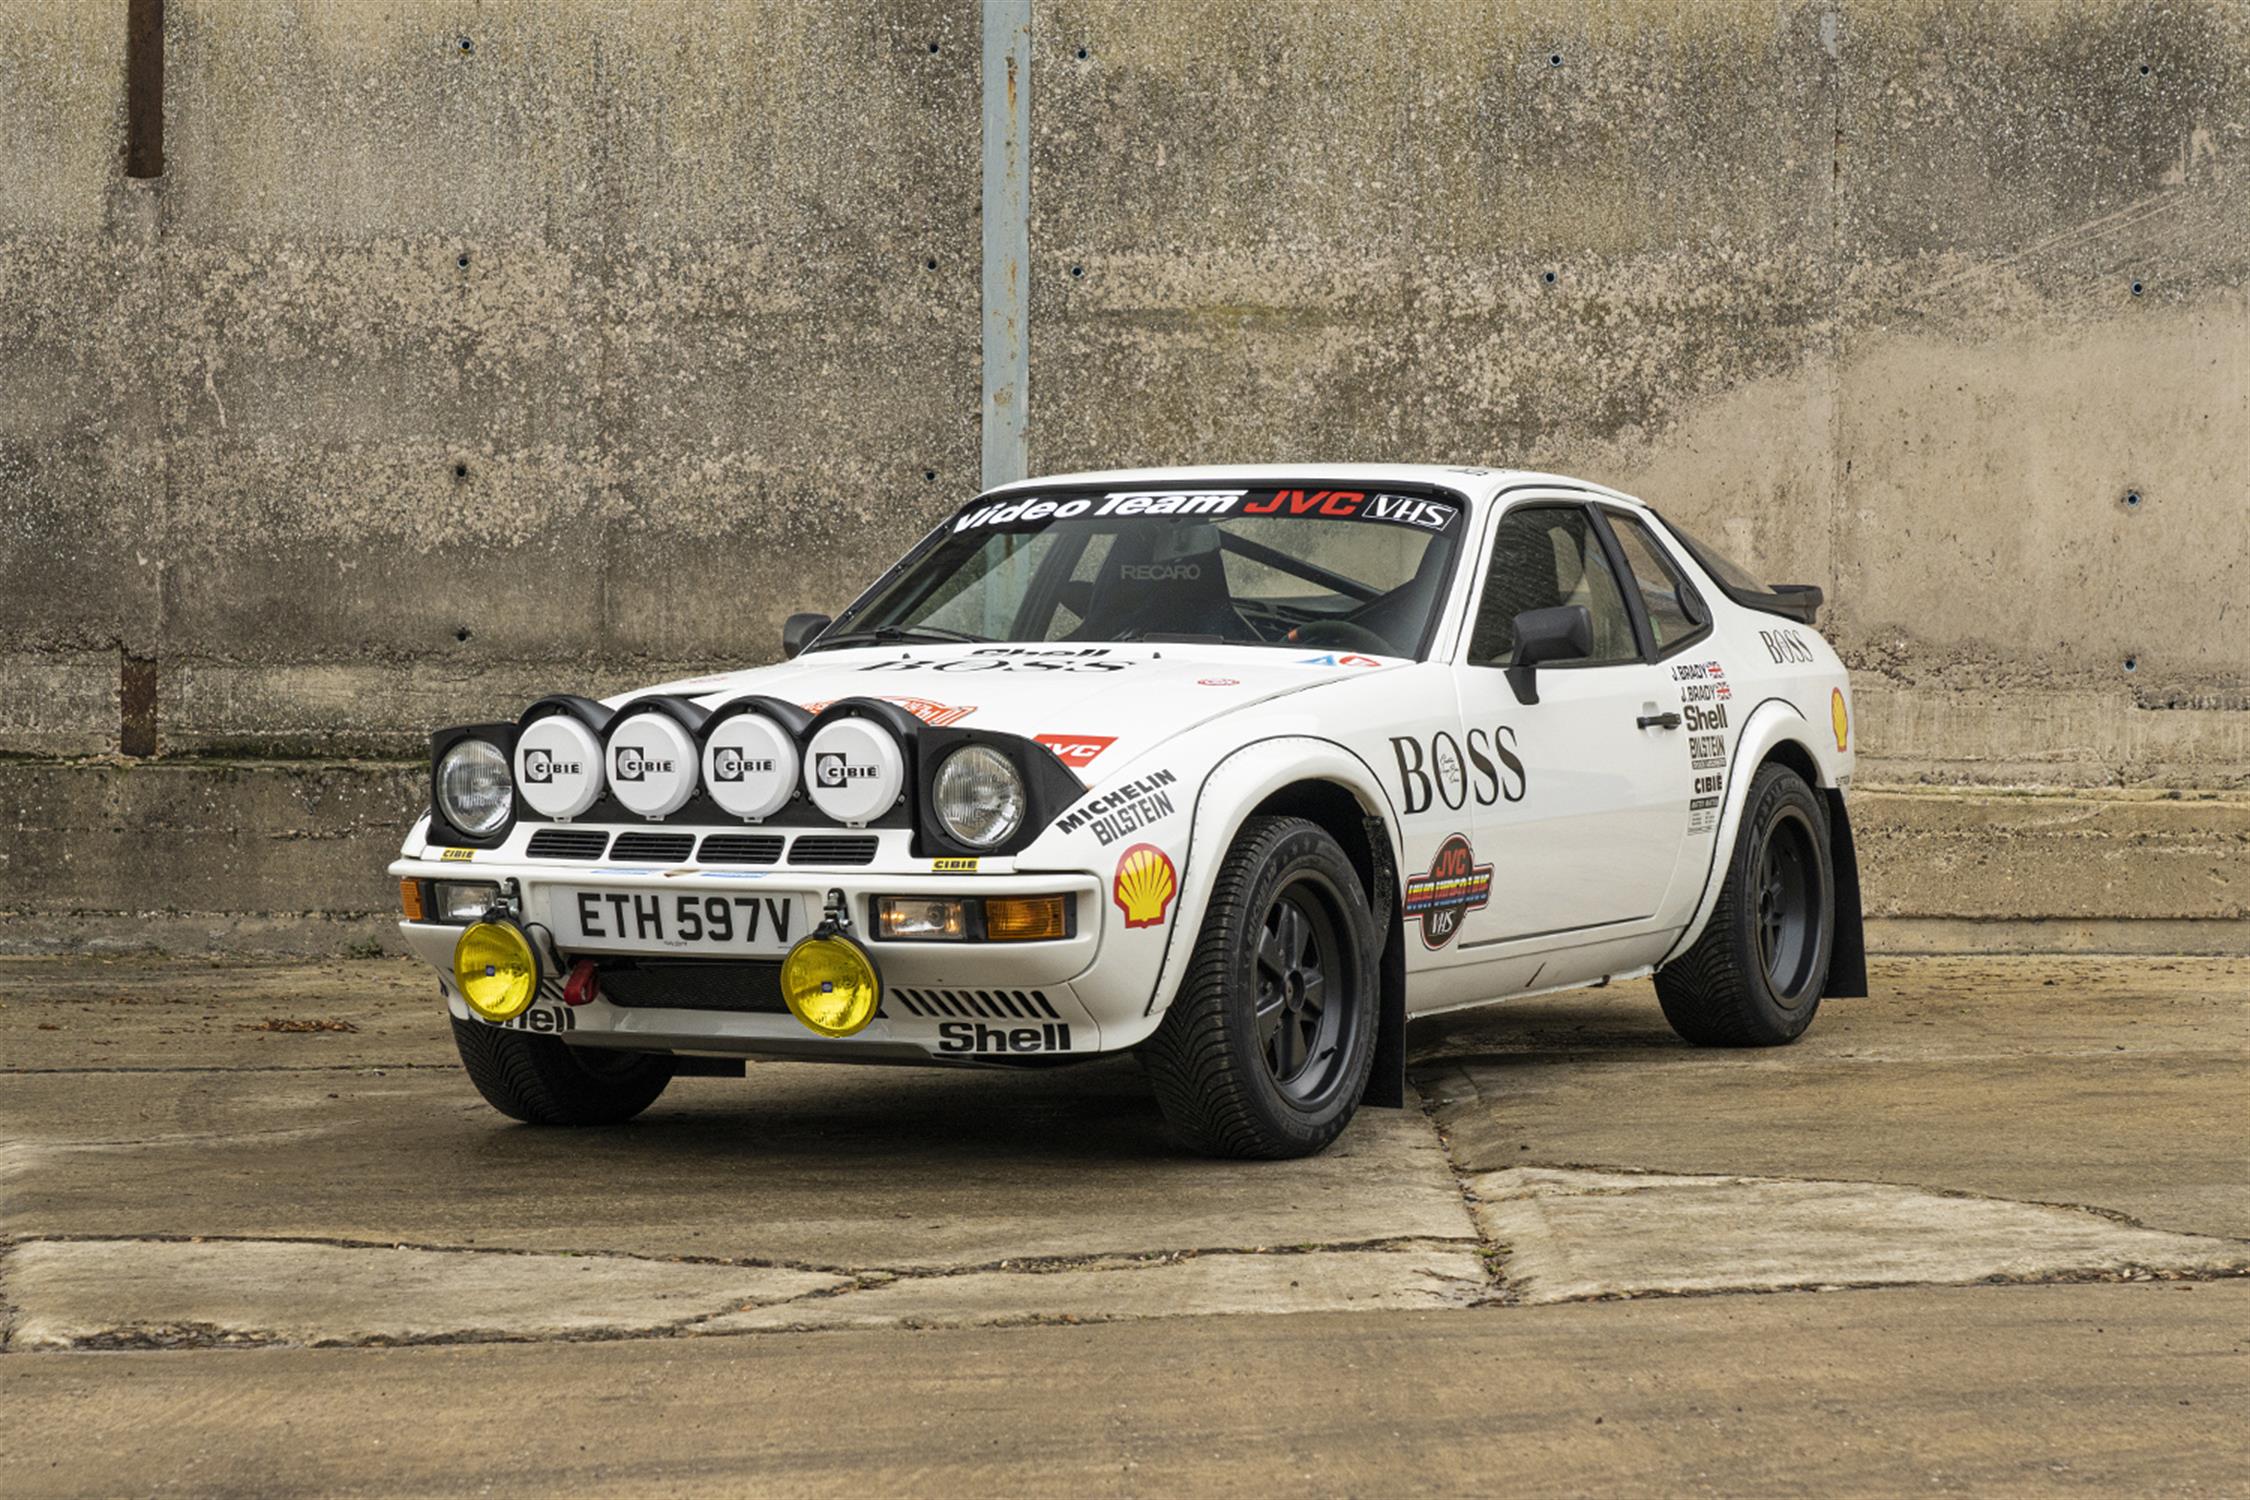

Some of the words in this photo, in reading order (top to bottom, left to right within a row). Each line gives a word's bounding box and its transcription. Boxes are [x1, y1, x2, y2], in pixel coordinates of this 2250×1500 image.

[953, 498, 1092, 533] Video
[1094, 490, 1249, 516] Team
[1243, 489, 1366, 515] JVC
[1374, 496, 1455, 528] VHS
[1120, 564, 1201, 581] RECARO
[964, 648, 1112, 657] Shell
[1758, 629, 1814, 664] BOSS
[857, 660, 1137, 673] BOSS
[1683, 703, 1728, 731] Shell
[1044, 742, 1102, 757] VC
[1689, 736, 1726, 759] BILSTEIN
[1388, 725, 1526, 815] BOSS
[1055, 769, 1177, 835] MICHELIN
[1090, 791, 1175, 847] BILSTEIN
[1436, 848, 1468, 878] JVC
[577, 892, 664, 939] ETH
[677, 896, 791, 943] 597V
[1431, 910, 1457, 935] VHS
[938, 1022, 1072, 1053] Shell
